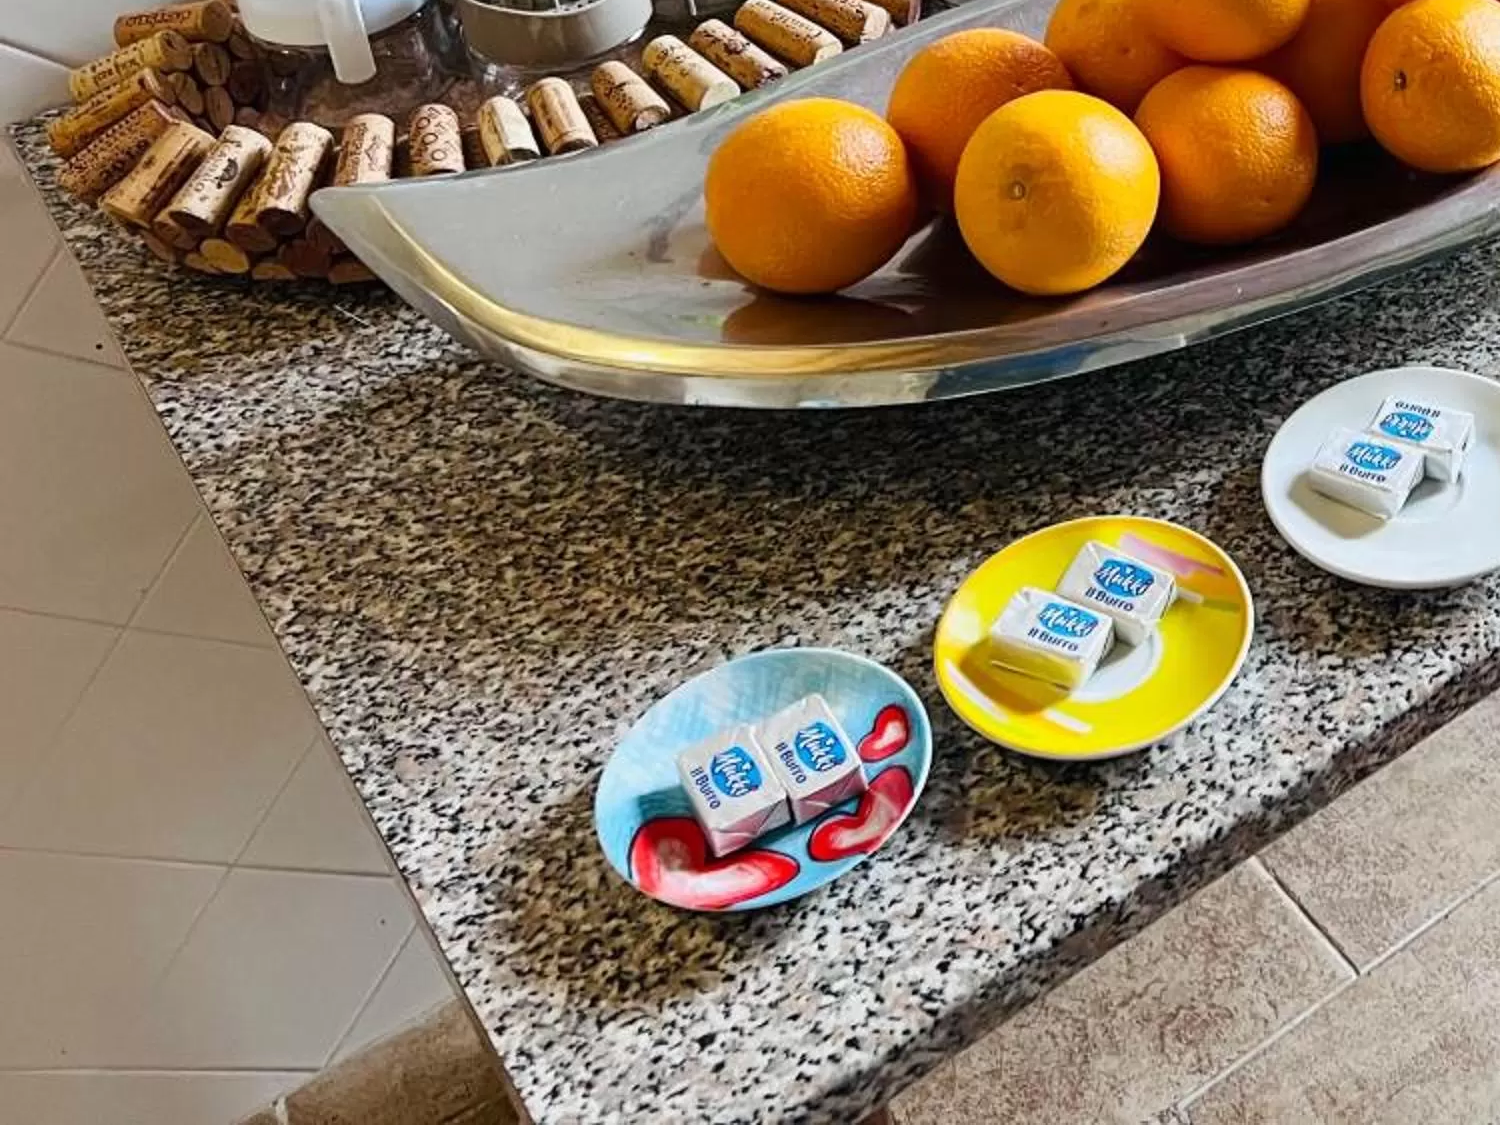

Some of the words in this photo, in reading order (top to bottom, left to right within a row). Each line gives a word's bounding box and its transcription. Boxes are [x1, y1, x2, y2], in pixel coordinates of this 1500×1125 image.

[1094, 562, 1152, 596] Mukki
[1095, 590, 1134, 612] Burro
[1040, 604, 1098, 637] Mukki
[1038, 630, 1079, 652] Burro
[780, 750, 807, 784] Burro
[695, 772, 721, 810] Burro
